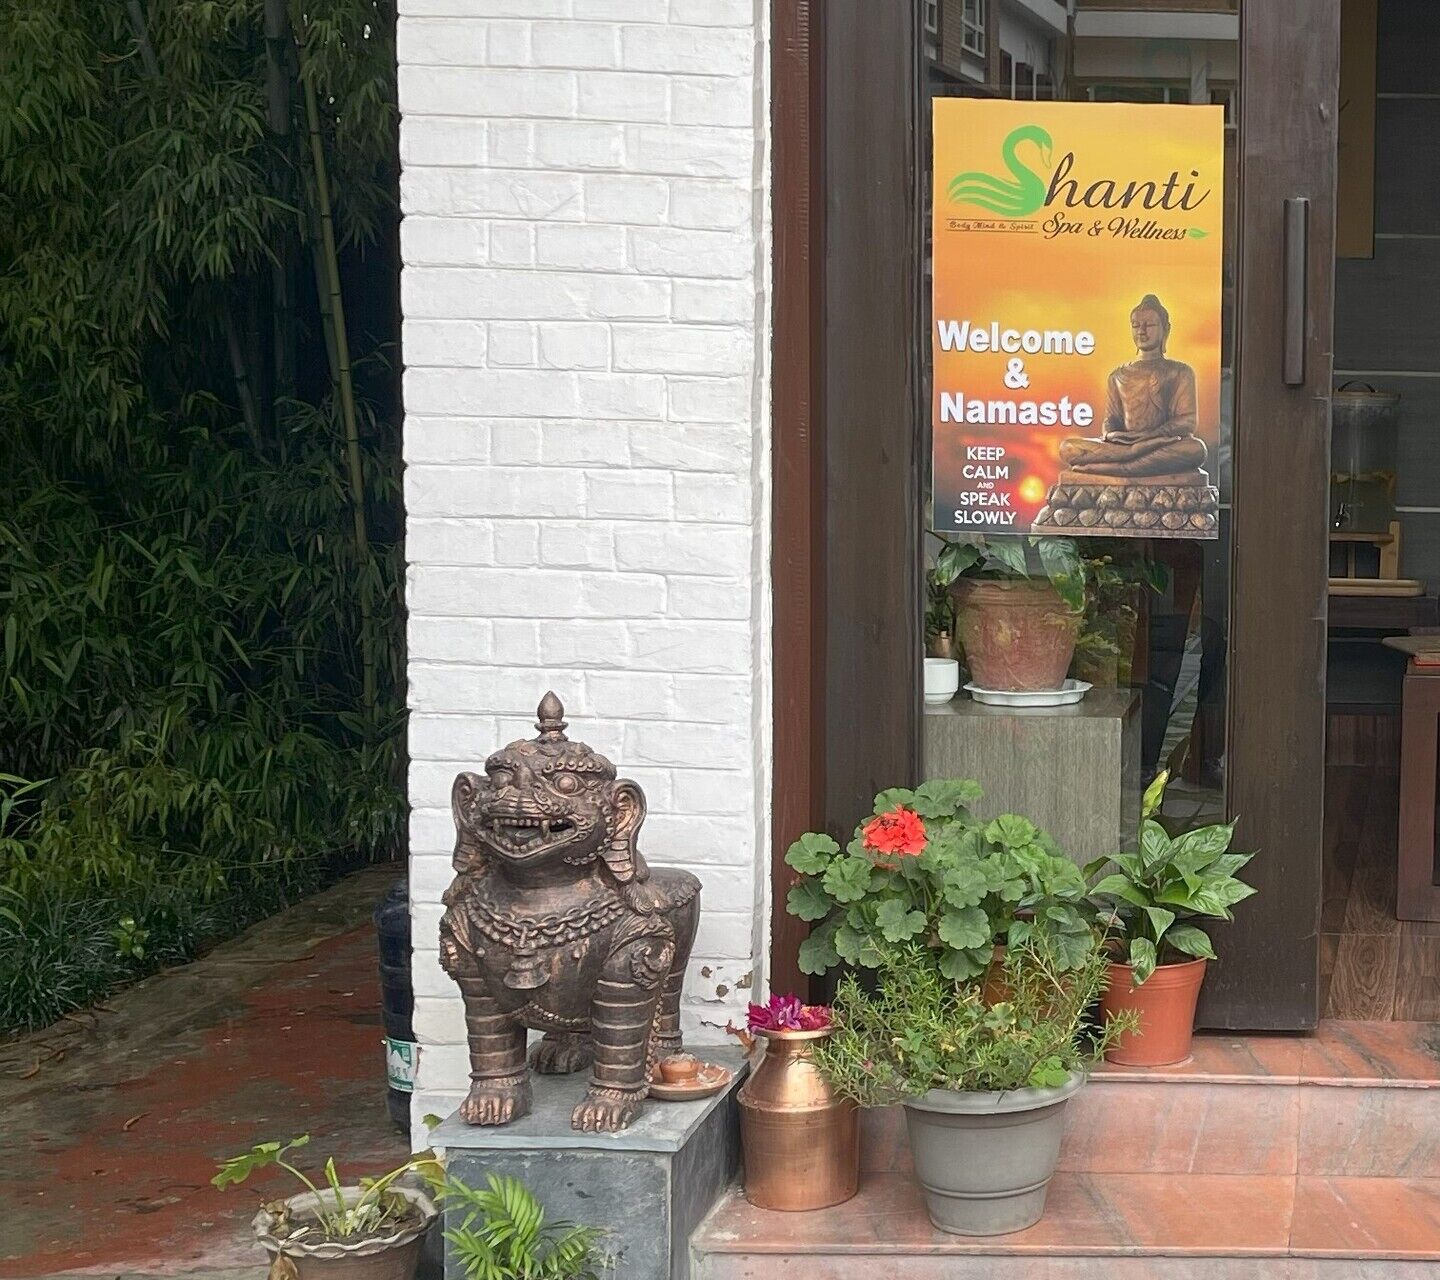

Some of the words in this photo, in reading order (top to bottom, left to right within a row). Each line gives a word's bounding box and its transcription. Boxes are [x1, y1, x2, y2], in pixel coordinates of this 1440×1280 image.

[1042, 211, 1082, 240] Spa
[1087, 220, 1104, 237] &
[1107, 216, 1187, 241] Wellness
[937, 320, 1096, 355] Welcome
[1003, 357, 1031, 390] &
[939, 391, 1094, 427] Namaste
[966, 446, 1006, 461] KEEP
[962, 465, 1009, 480] CALM
[976, 482, 995, 490] AND
[960, 492, 1011, 507] SPEAK
[954, 510, 1017, 526] SLOWLY
